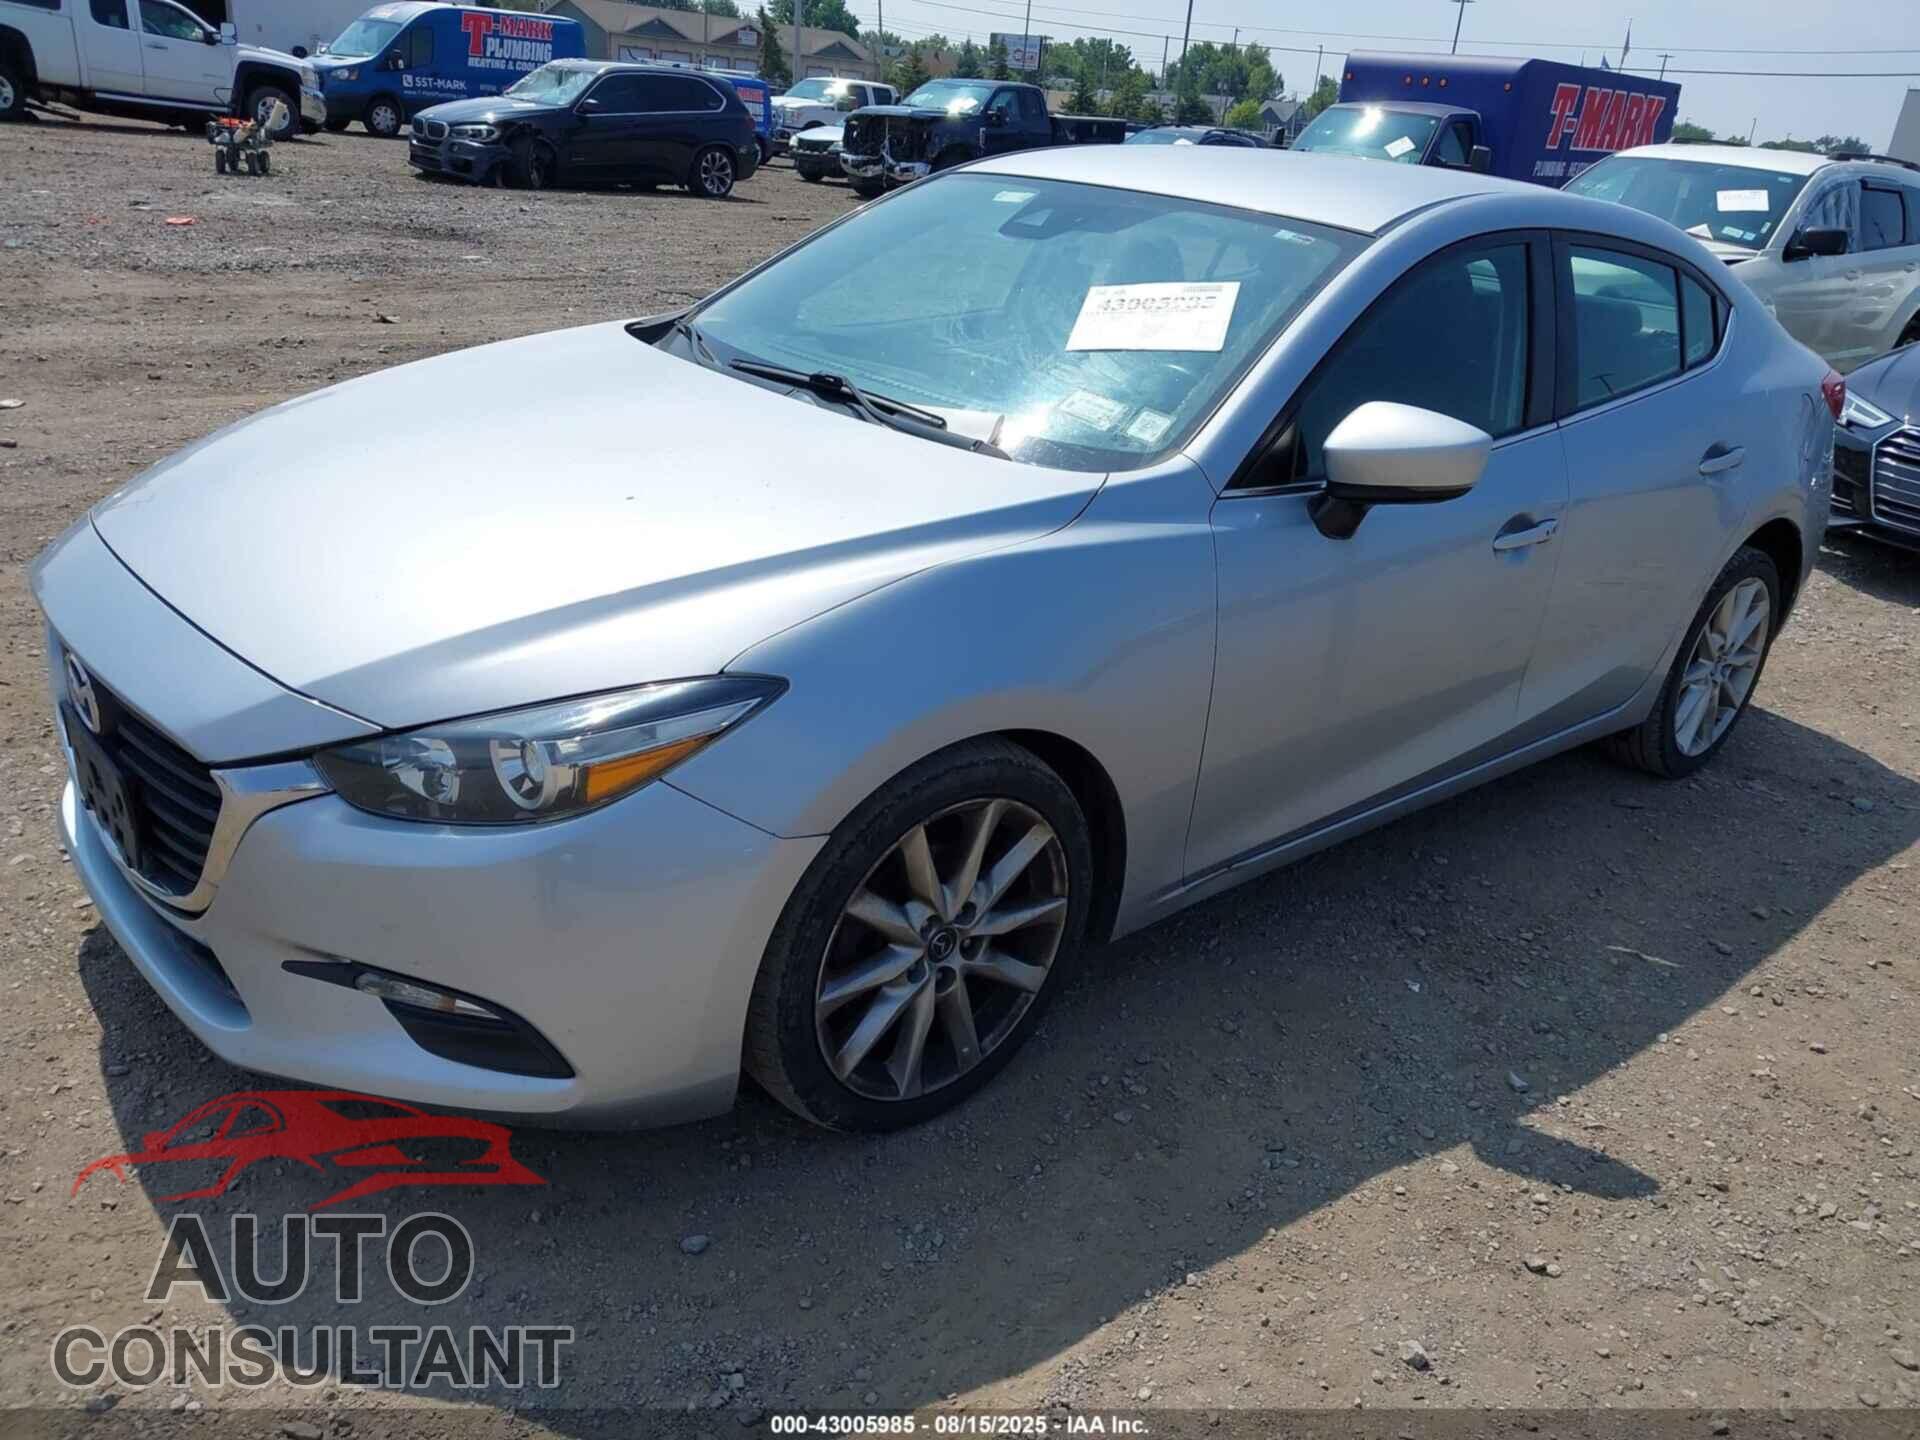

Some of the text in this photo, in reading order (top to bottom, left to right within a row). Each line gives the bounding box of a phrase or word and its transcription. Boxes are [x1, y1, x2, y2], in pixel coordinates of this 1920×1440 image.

[461, 11, 554, 57] T-MARK
[485, 37, 552, 60] PLUMBING
[467, 57, 506, 70] HEATING
[1545, 82, 1666, 153] T-MARK
